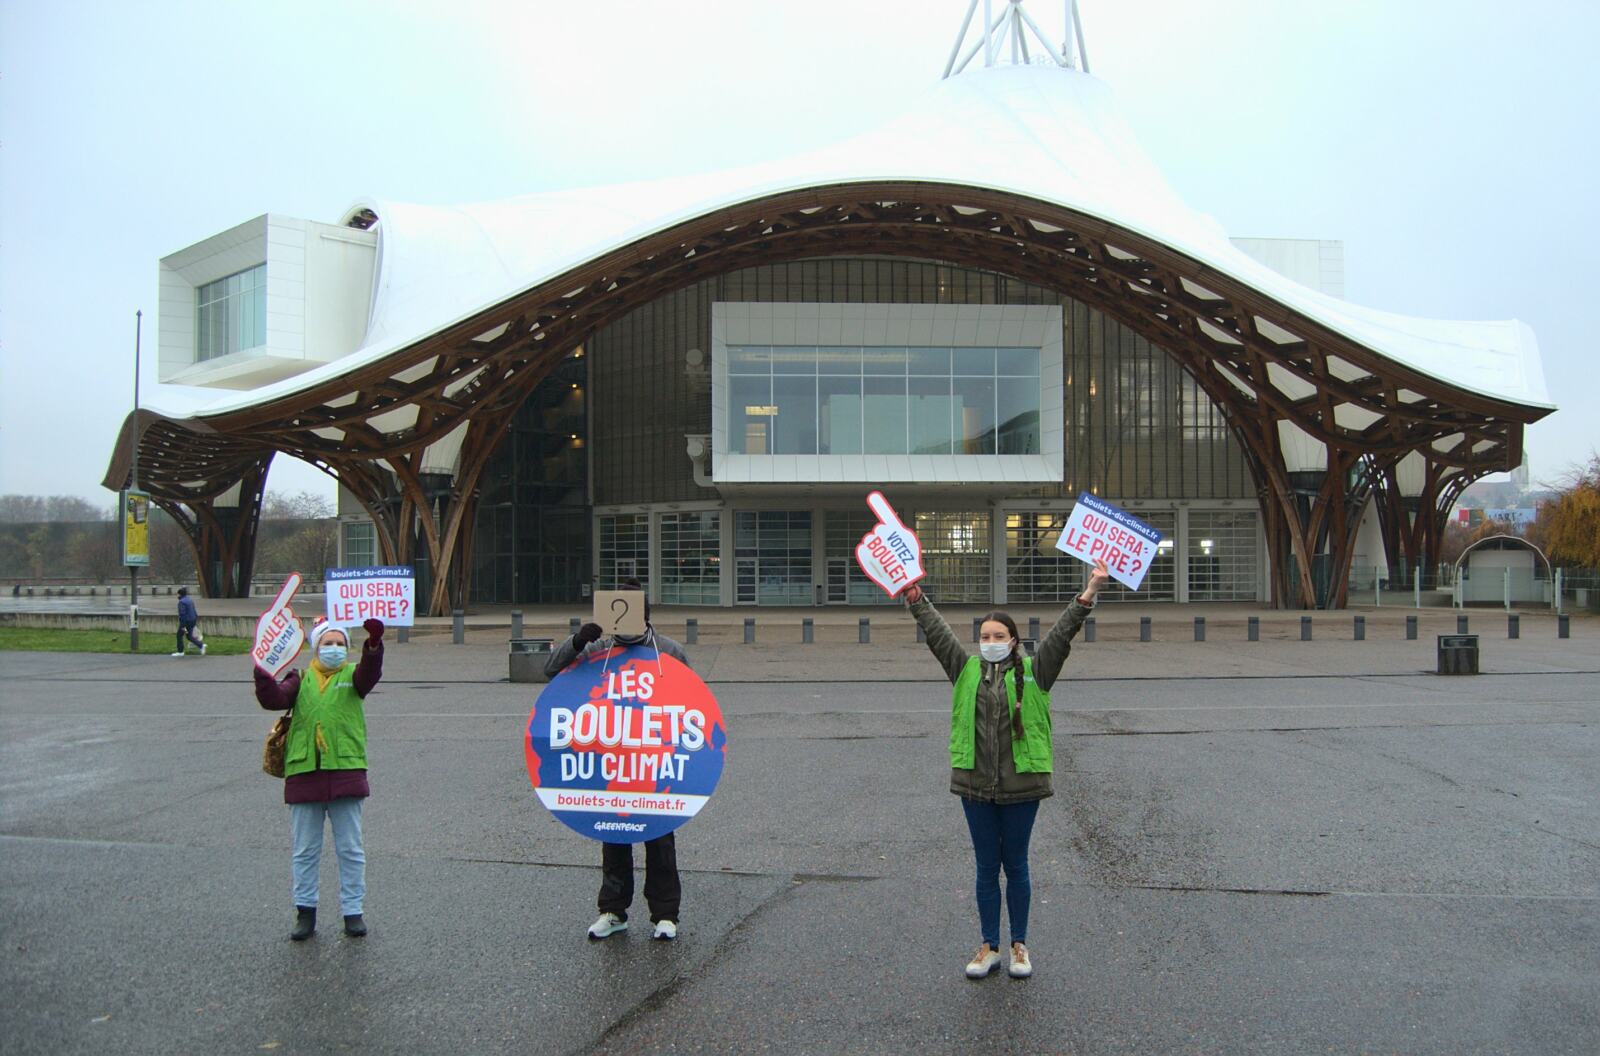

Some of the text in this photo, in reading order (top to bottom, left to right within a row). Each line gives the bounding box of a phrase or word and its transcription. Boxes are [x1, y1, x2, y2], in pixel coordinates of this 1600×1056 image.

[1083, 495, 1158, 540] boulets-du-climat.fr
[887, 531, 915, 565] VOTEZ
[1065, 527, 1090, 553] LE
[1082, 513, 1144, 557] QUI SERA
[331, 568, 410, 578] boulets-du-climat.fr
[867, 536, 908, 585] BOULET
[339, 582, 403, 599] QUI SERA
[334, 602, 355, 622] LE
[611, 598, 629, 630] ?
[255, 609, 289, 660] BOULET
[265, 624, 296, 666] DU CLIMAT
[607, 670, 655, 701] LES
[550, 703, 706, 751] BOULETS
[560, 752, 690, 783] DU CLIMAT
[557, 793, 686, 811] boulets-du-climat.fr
[593, 821, 647, 832] GREENPEACE
